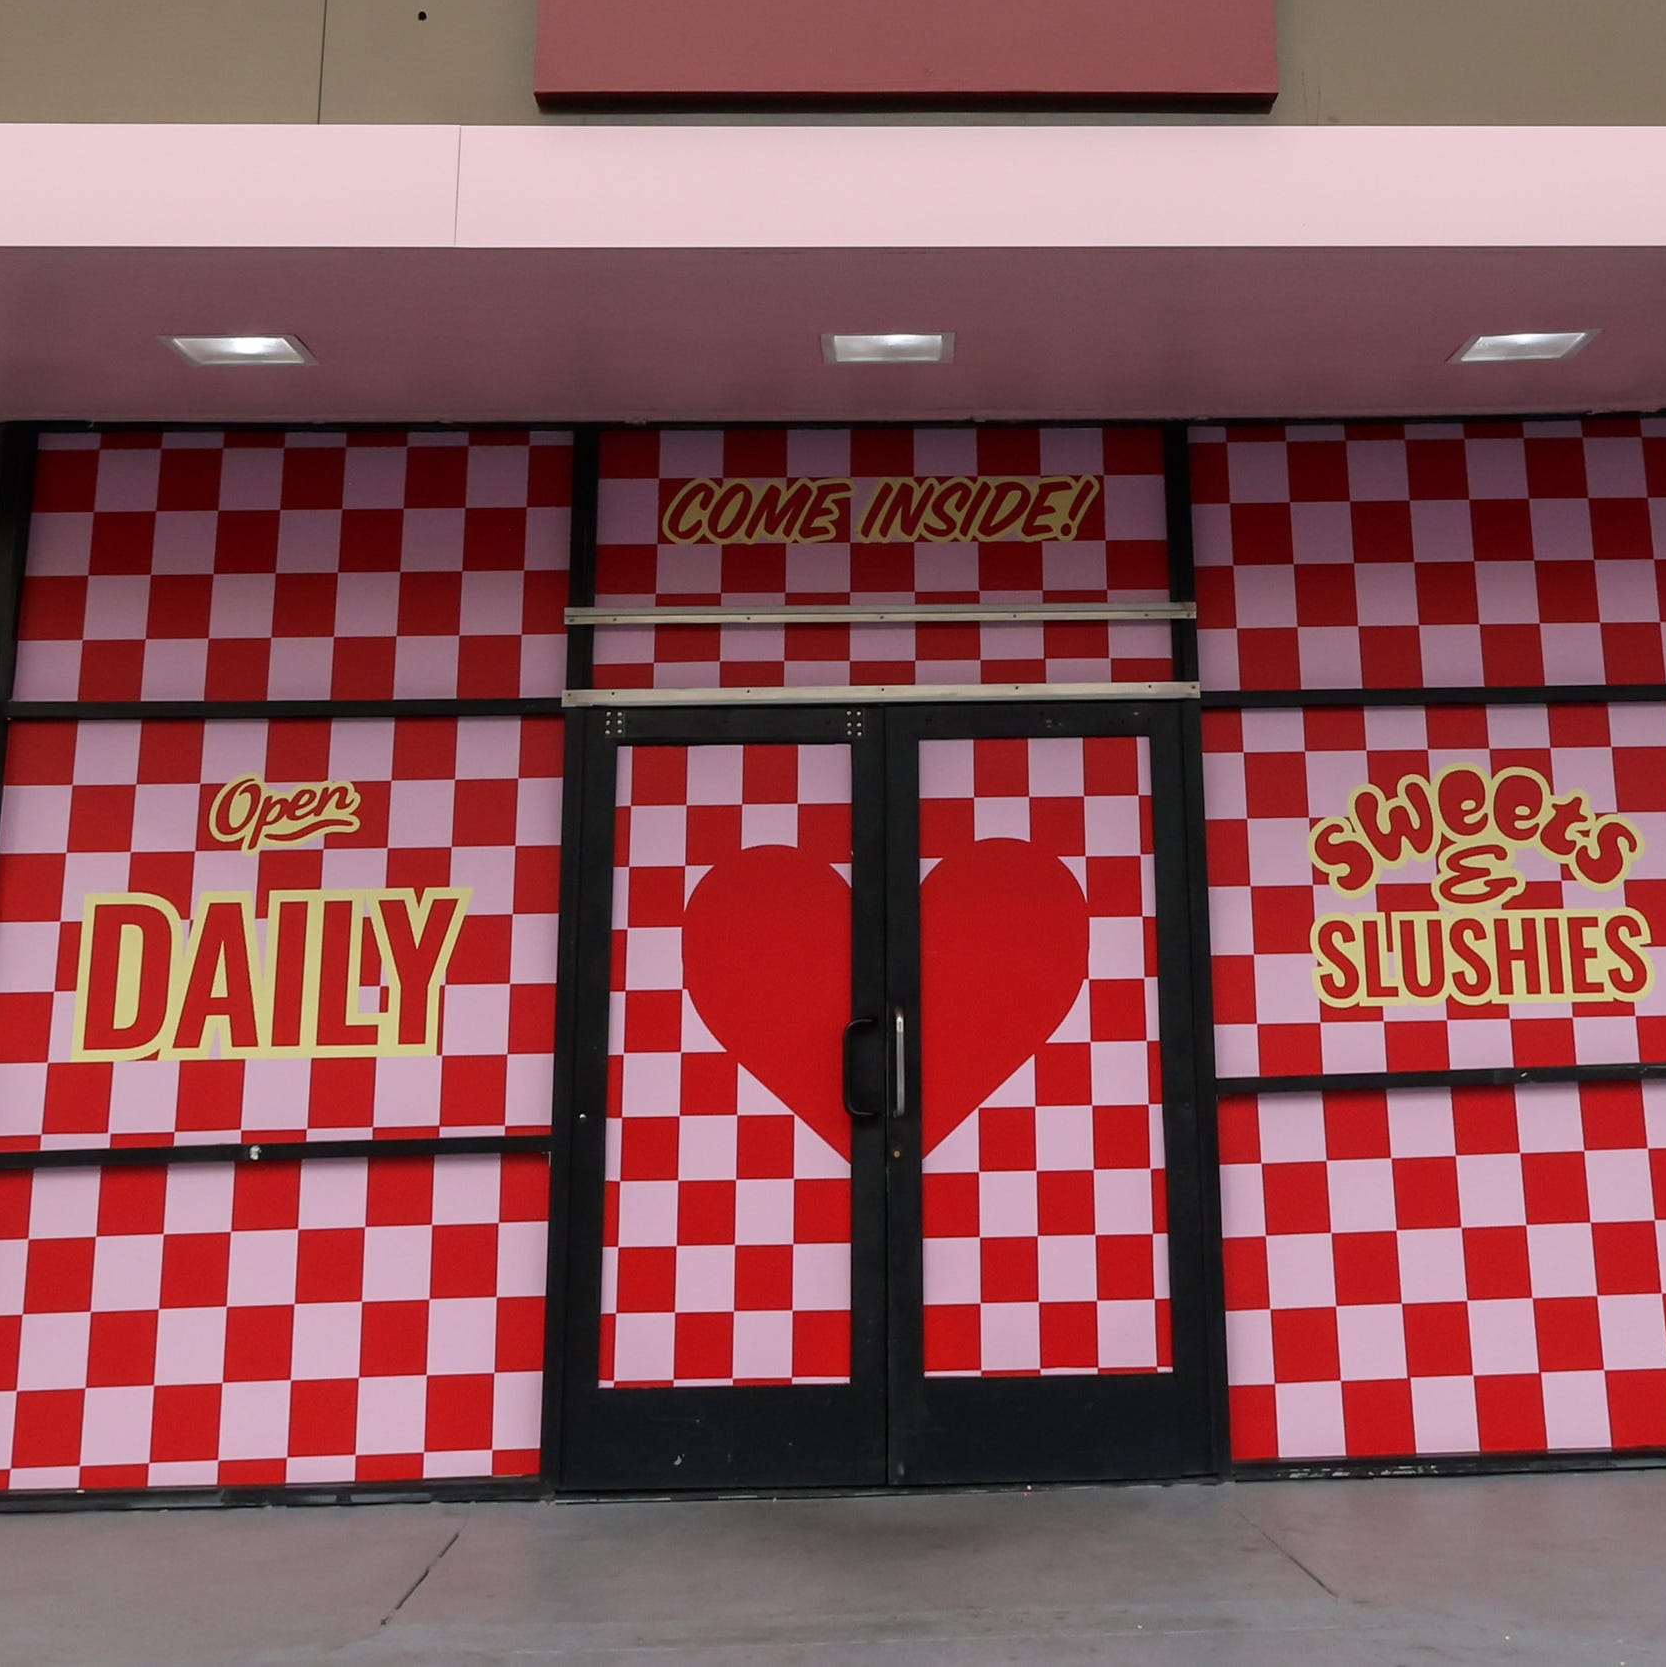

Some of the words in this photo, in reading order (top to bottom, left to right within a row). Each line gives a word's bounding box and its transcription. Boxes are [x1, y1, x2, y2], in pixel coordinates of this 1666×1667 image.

[662, 477, 855, 544] COME
[857, 475, 1099, 543] INSIDE!
[209, 772, 361, 855] Open
[1433, 841, 1525, 909] &
[71, 887, 473, 1062] DAILY
[1310, 907, 1655, 1008] SLUSHIES
